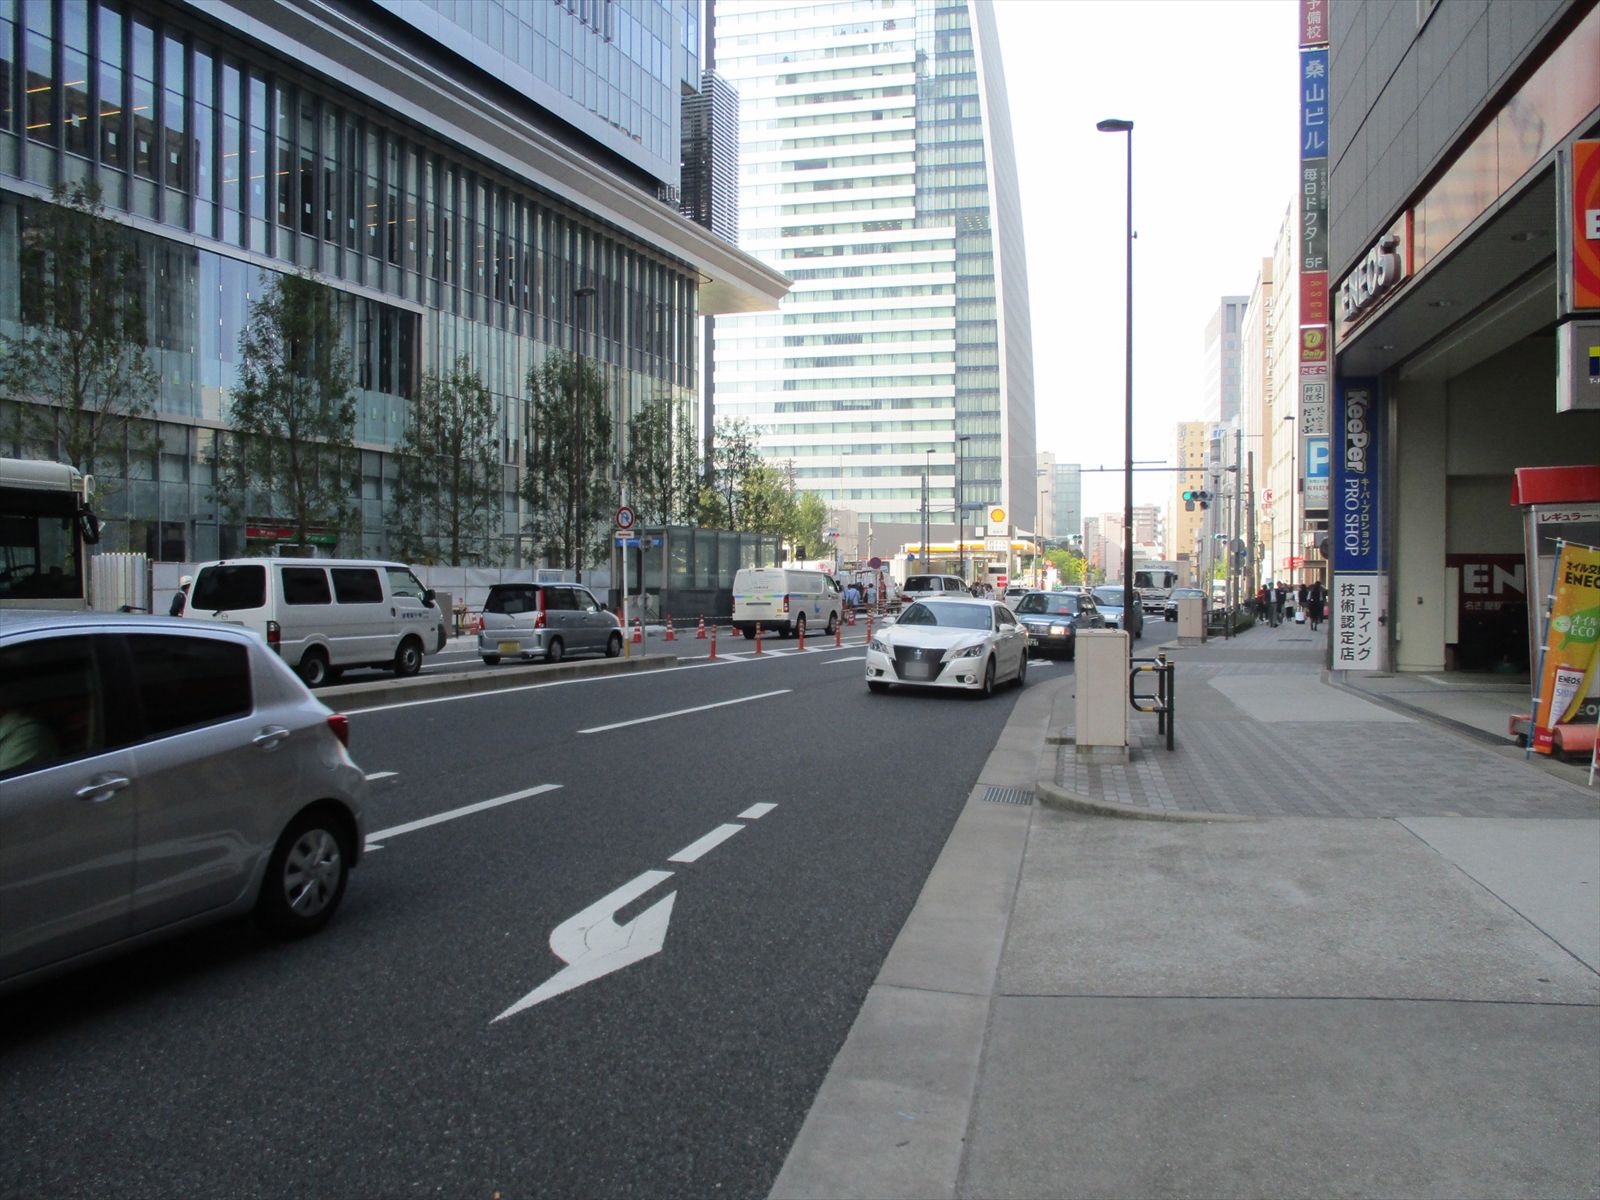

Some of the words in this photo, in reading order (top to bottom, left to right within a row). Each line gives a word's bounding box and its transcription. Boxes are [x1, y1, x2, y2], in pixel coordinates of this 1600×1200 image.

[1305, 60, 1325, 150] 桑山ビル
[1303, 168, 1318, 254] 毎日ドクター
[1305, 257, 1323, 268] 5F
[1341, 236, 1400, 316] ENEOS
[1310, 441, 1329, 474] P
[1344, 479, 1359, 510] PRO
[1344, 514, 1359, 556] SHOP
[1361, 478, 1370, 556] キーパープロショップ
[1340, 583, 1355, 661] 技術認定店
[1358, 584, 1371, 661] コーティング
[1571, 624, 1595, 637] ECO
